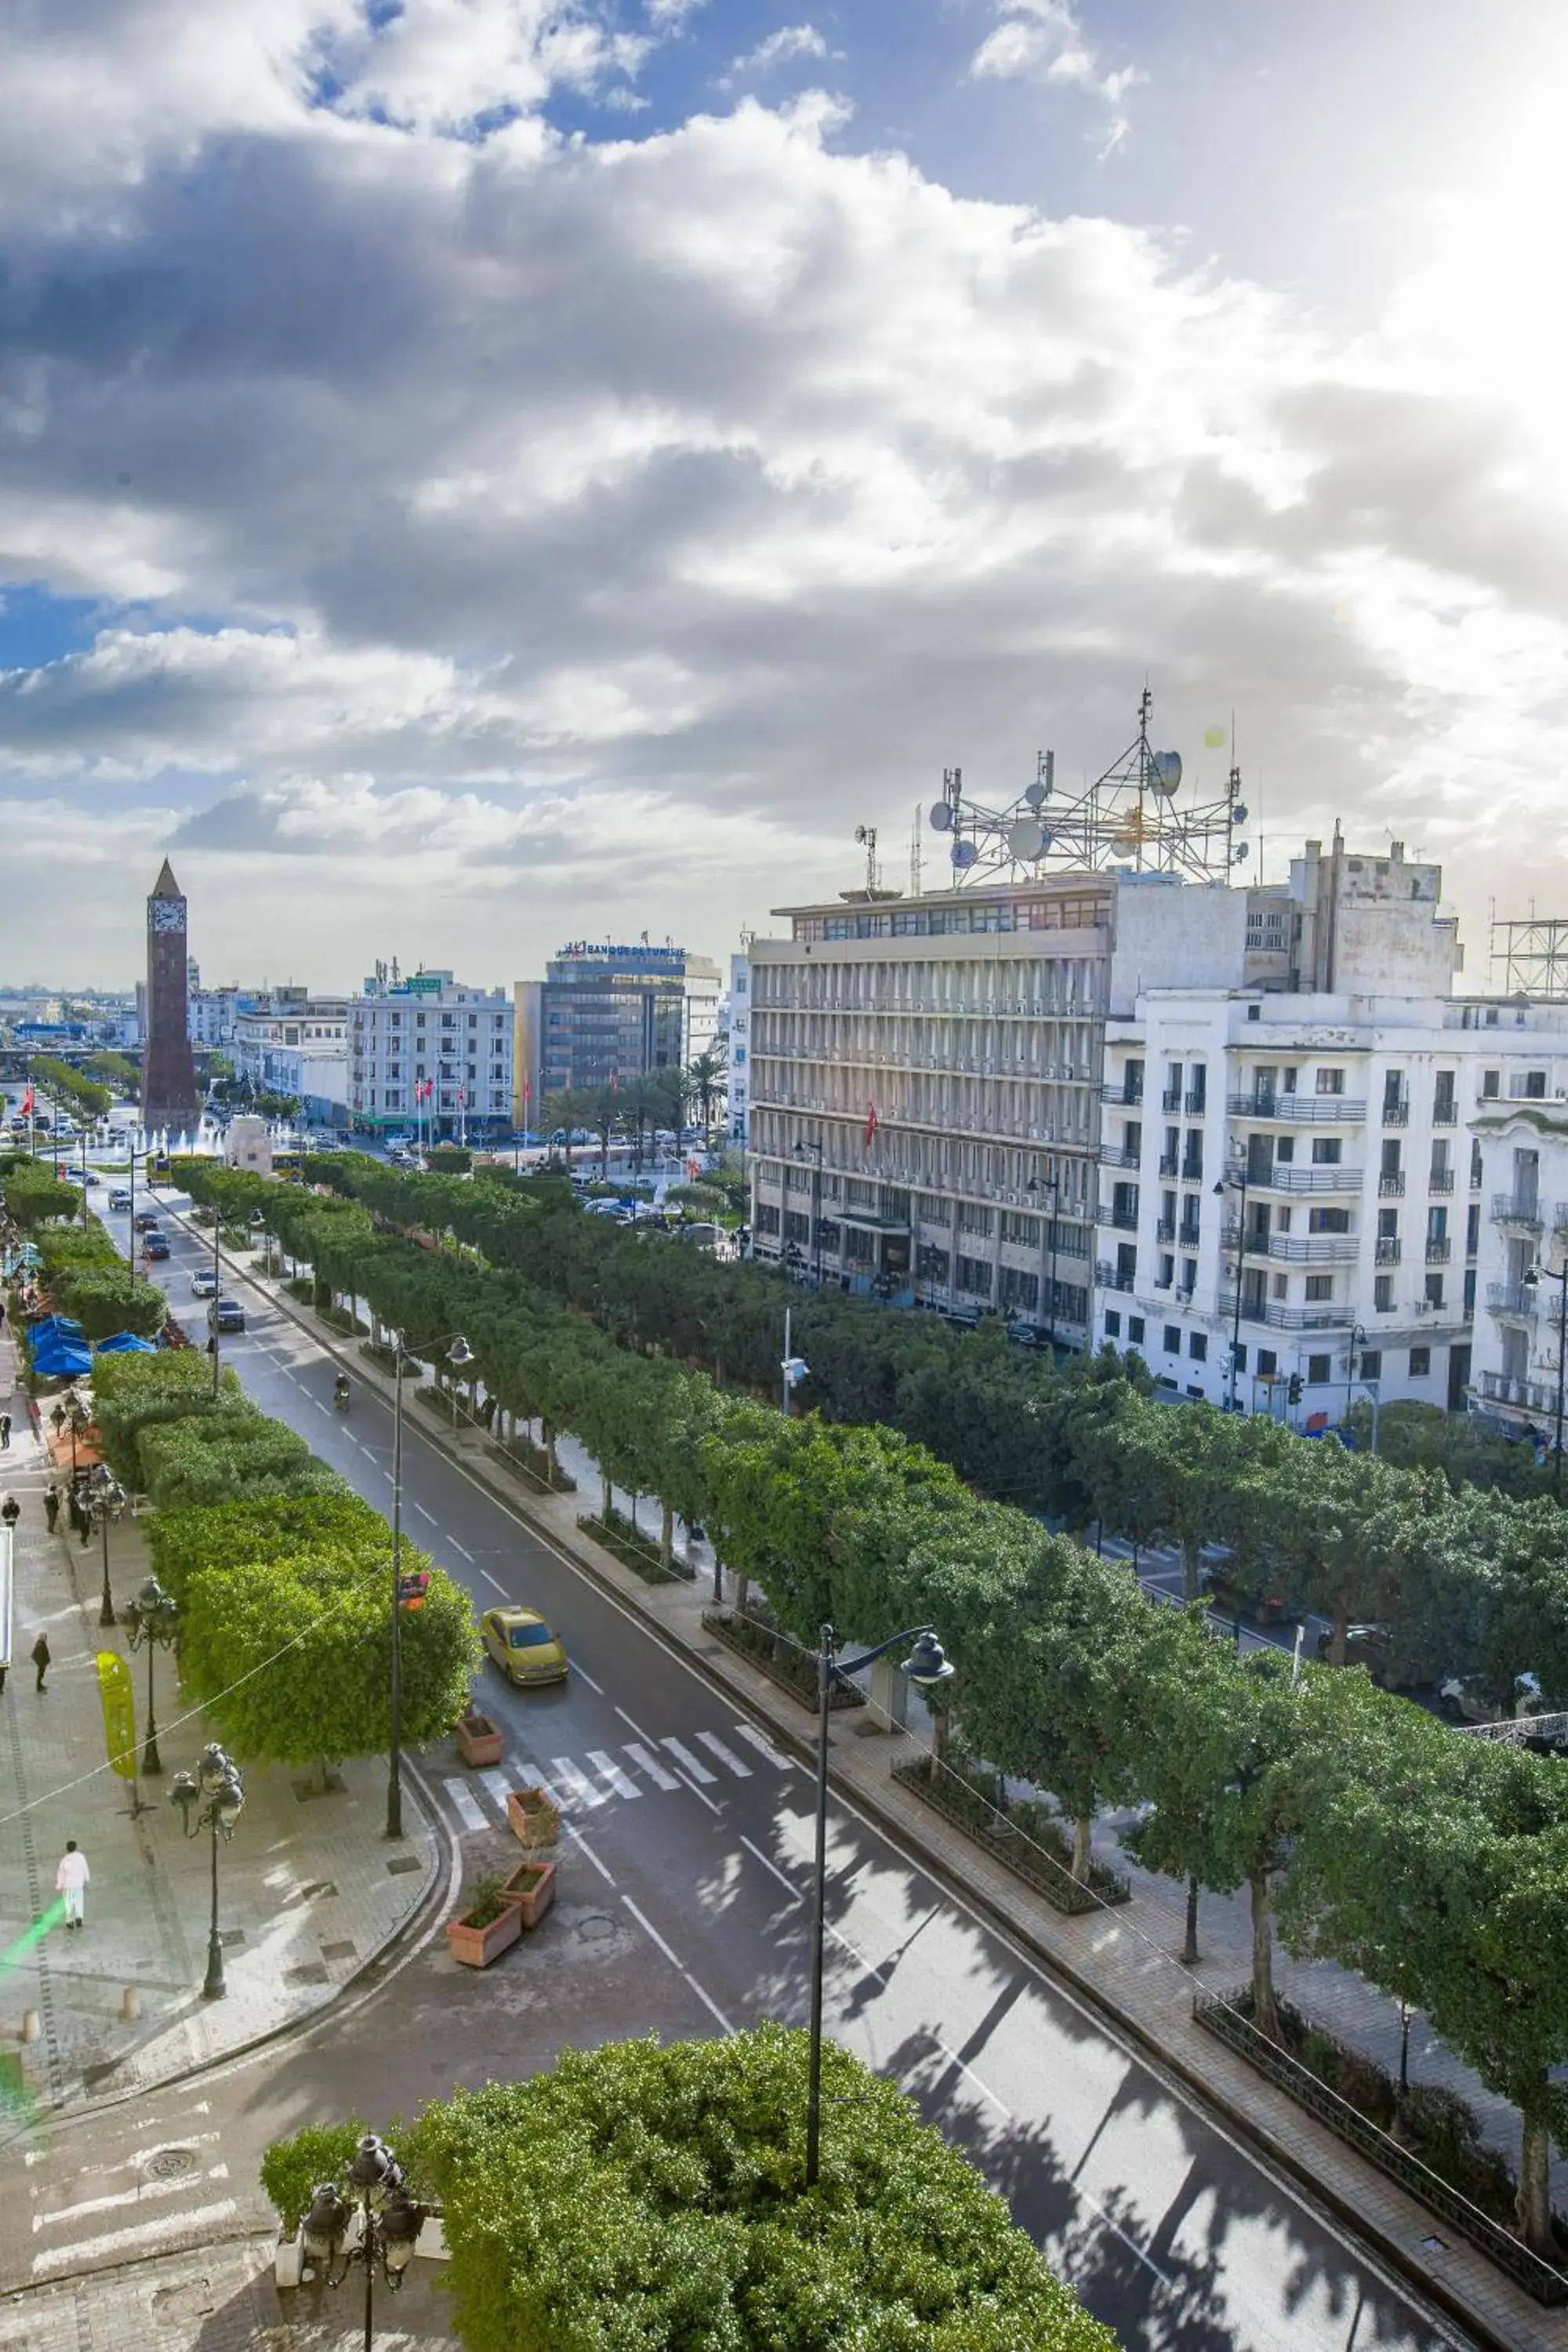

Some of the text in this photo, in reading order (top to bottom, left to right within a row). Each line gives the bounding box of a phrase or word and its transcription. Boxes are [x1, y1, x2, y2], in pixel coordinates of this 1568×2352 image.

[587, 945, 630, 956] BANQUE
[632, 946, 646, 956] DE
[647, 947, 686, 956] TUNISIE
